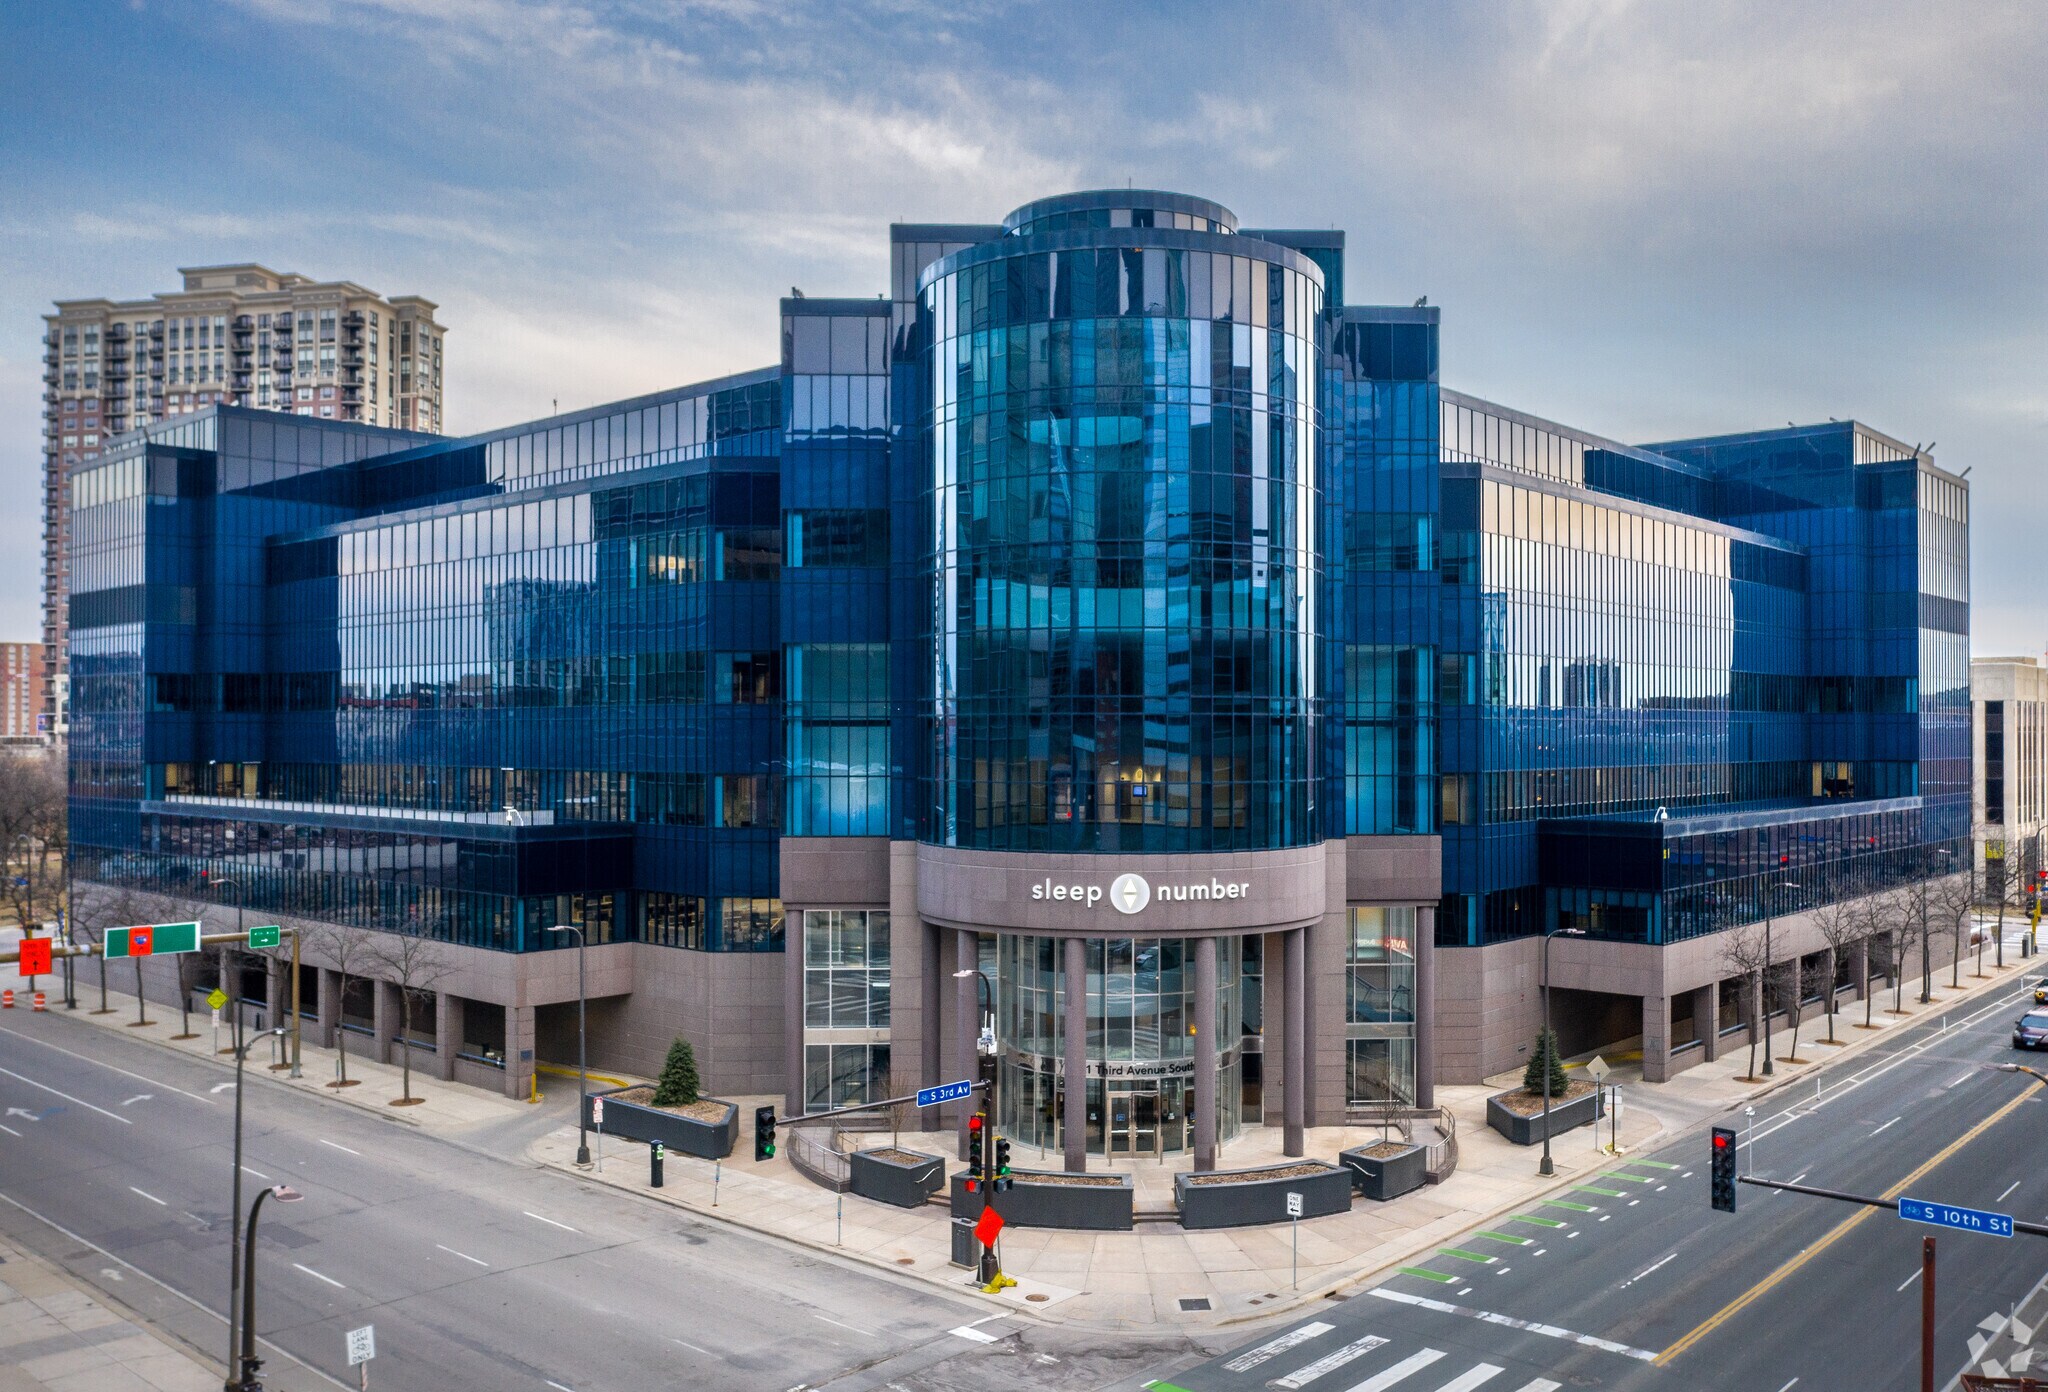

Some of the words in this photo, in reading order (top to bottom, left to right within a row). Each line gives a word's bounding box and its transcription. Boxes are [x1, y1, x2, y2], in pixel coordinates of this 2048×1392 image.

[1031, 878, 1103, 908] sleep
[1157, 877, 1250, 901] number
[1095, 1065, 1123, 1075] Third
[1126, 1065, 1166, 1075] Avenue
[931, 1091, 936, 1101] S
[940, 1087, 954, 1099] 3rd
[957, 1085, 969, 1095] Av
[1924, 1207, 1935, 1219] S
[1943, 1210, 1981, 1228] 10th
[1989, 1218, 2009, 1232] St
[352, 1329, 367, 1338] LEFT
[352, 1335, 368, 1344] LANE
[352, 1351, 371, 1363] ONLY
